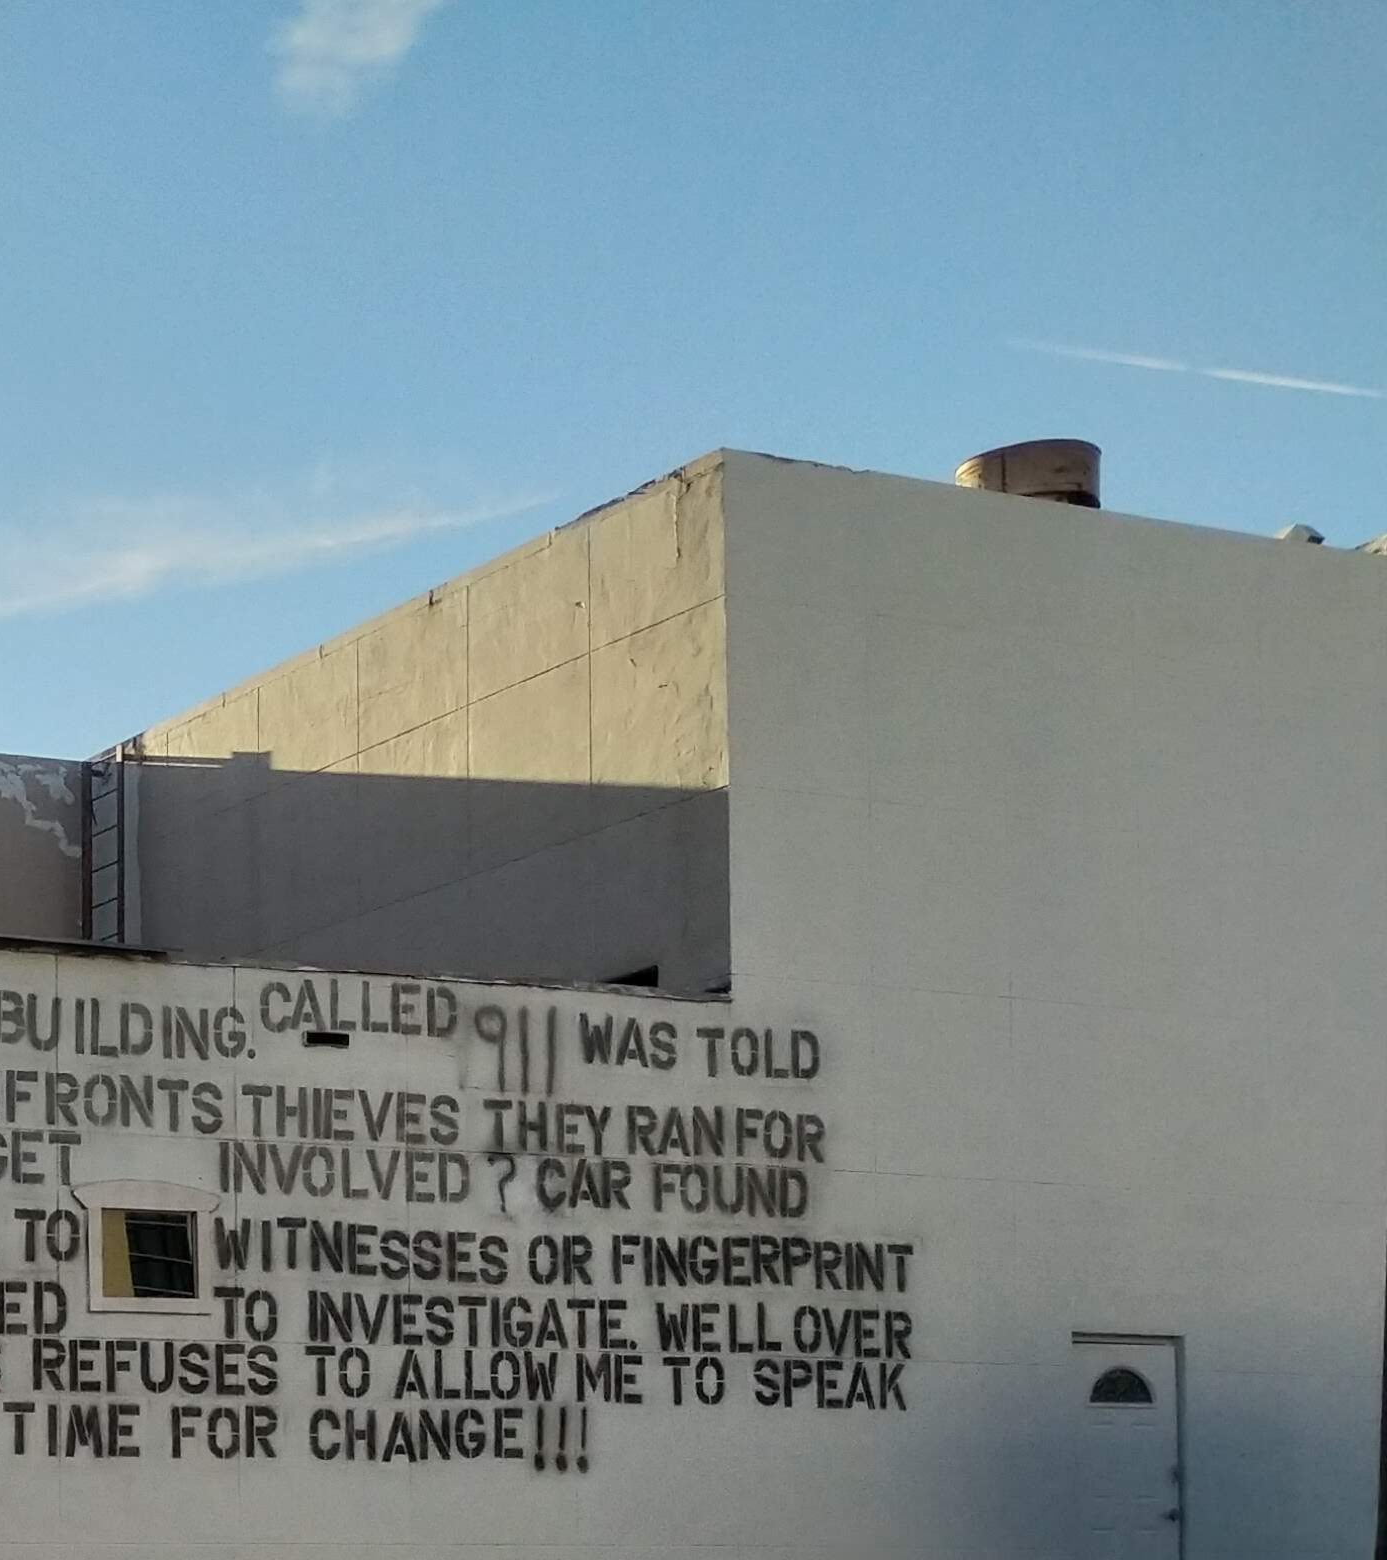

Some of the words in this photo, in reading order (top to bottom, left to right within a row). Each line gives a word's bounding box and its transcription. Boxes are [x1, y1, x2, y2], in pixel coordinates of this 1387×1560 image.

[260, 979, 457, 1037] CALLED
[475, 1005, 557, 1096] 911
[580, 1012, 677, 1070] WAS
[697, 1026, 820, 1078] TOLD
[242, 1084, 459, 1144] THIEVES
[484, 1100, 612, 1155] THEY
[627, 1105, 723, 1157] RAN
[736, 1108, 825, 1163] FOR
[536, 1158, 629, 1209] CAR
[653, 1165, 807, 1218] FOUND
[14, 1209, 80, 1262] TO
[214, 1215, 508, 1285] WITNESSES
[528, 1235, 593, 1286] OR
[612, 1235, 913, 1292] FINGERPRINT
[214, 1287, 277, 1341] TO
[308, 1290, 638, 1350] INVESTIGATE.
[656, 1302, 781, 1352] WELL
[793, 1305, 912, 1358] OVER
[33, 1340, 277, 1395] REFUSES
[305, 1346, 370, 1398] TO
[393, 1350, 557, 1402] ALLOW
[577, 1354, 643, 1404] ME
[663, 1357, 723, 1405] TO
[753, 1358, 907, 1411] SPEAK
[3, 1402, 139, 1457] TIME
[171, 1406, 278, 1459] FOR
